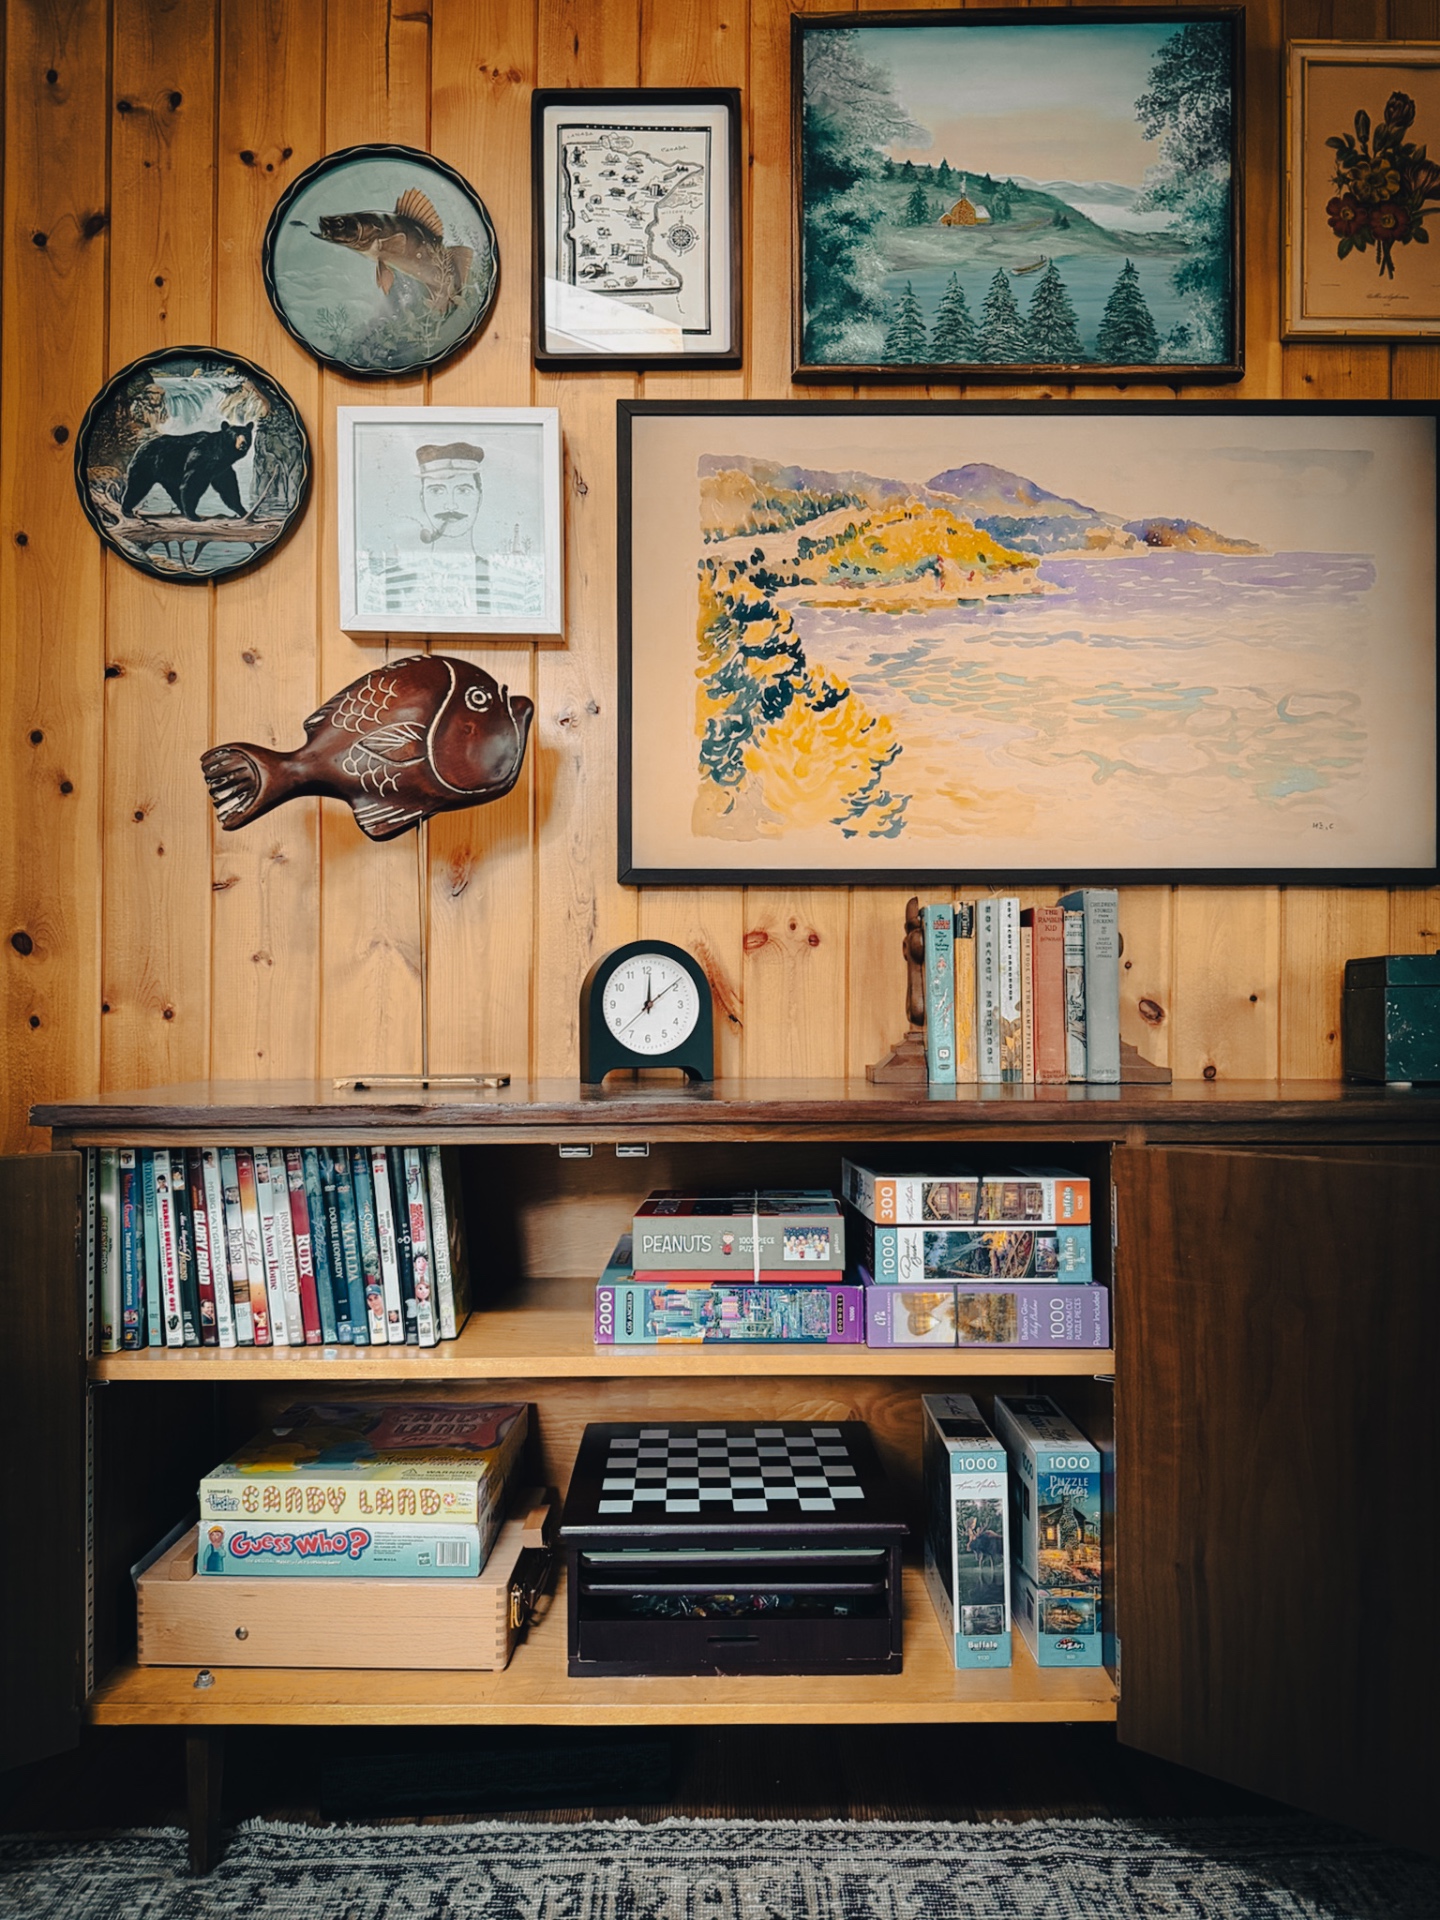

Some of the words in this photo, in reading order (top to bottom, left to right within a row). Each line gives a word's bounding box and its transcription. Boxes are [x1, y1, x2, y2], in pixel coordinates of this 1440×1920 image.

[626, 971, 634, 979] 11
[642, 966, 652, 975] 12
[661, 971, 666, 979] 1
[615, 983, 624, 992] 10
[672, 983, 679, 992] 2
[610, 1000, 616, 1009] 9
[677, 1000, 684, 1009] 3
[615, 1018, 622, 1026] 8
[673, 1017, 679, 1025] 4
[629, 1030, 635, 1038] 7
[645, 1034, 651, 1043] 6
[661, 1029, 668, 1038] 5
[208, 1181, 215, 1193] MY
[145, 1192, 155, 1218] VELVET
[208, 1193, 216, 1209] BIG
[881, 1187, 893, 1219] 300
[1063, 1187, 1072, 1218] Buffalo
[162, 1199, 170, 1229] FERRIS
[210, 1210, 218, 1232] FAT
[263, 1216, 274, 1232] Fly
[328, 1207, 340, 1238] DOUBLE
[193, 1210, 208, 1249] GLORY
[228, 1228, 242, 1244] BIG
[247, 1229, 259, 1248] Step
[279, 1211, 292, 1248] ROMAN
[758, 1236, 775, 1244] PIECE
[164, 1231, 174, 1276] BUELLER'S
[211, 1232, 221, 1263] GREEK
[264, 1233, 275, 1258] Away
[342, 1221, 359, 1283] MATILDA
[432, 1201, 448, 1284] GHOSTBUSTERS
[643, 1235, 712, 1253] PEANUTS
[230, 1244, 244, 1265] FISH
[249, 1251, 262, 1266] Up
[296, 1233, 313, 1277] RUDY
[330, 1240, 344, 1279] JEOPARDY
[883, 1235, 895, 1276] 1000
[1065, 1237, 1075, 1272] Buffalo
[196, 1250, 211, 1285] ROAD
[267, 1260, 279, 1290] Home
[284, 1251, 297, 1294] HOLIDAY
[215, 1263, 226, 1305] WEDDING
[600, 1291, 612, 1335] 2000
[1020, 1297, 1028, 1315] Glow
[1074, 1297, 1082, 1319] PIECES
[1092, 1291, 1100, 1321] Included
[1021, 1316, 1029, 1341] Balloon
[1050, 1298, 1065, 1339] 1000
[1074, 1319, 1082, 1341] PUZZLE
[959, 1458, 997, 1470] 1000
[1049, 1457, 1090, 1469] 1000
[1045, 1484, 1089, 1498] Collector
[1049, 1475, 1089, 1487] PUZZLE
[242, 1485, 347, 1514] CANDY
[358, 1487, 441, 1516] LAND
[967, 1640, 998, 1649] Buffalo
